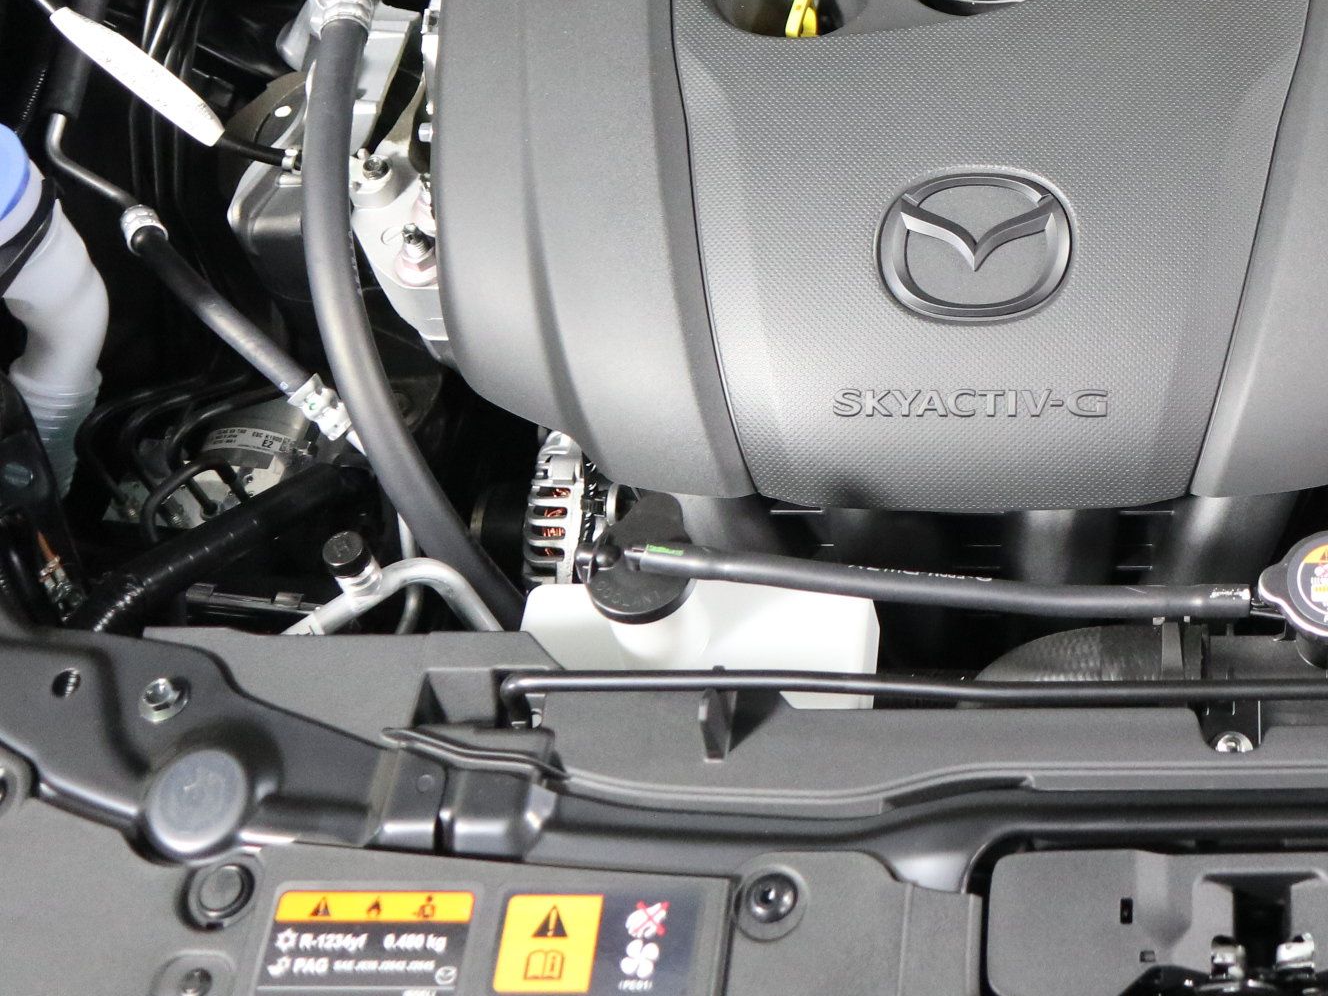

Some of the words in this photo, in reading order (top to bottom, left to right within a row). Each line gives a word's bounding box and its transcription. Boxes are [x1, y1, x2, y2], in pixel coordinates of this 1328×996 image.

[832, 388, 1109, 418] SKYACTIV-G
[425, 934, 447, 953] kg
[293, 957, 329, 974] PAG
